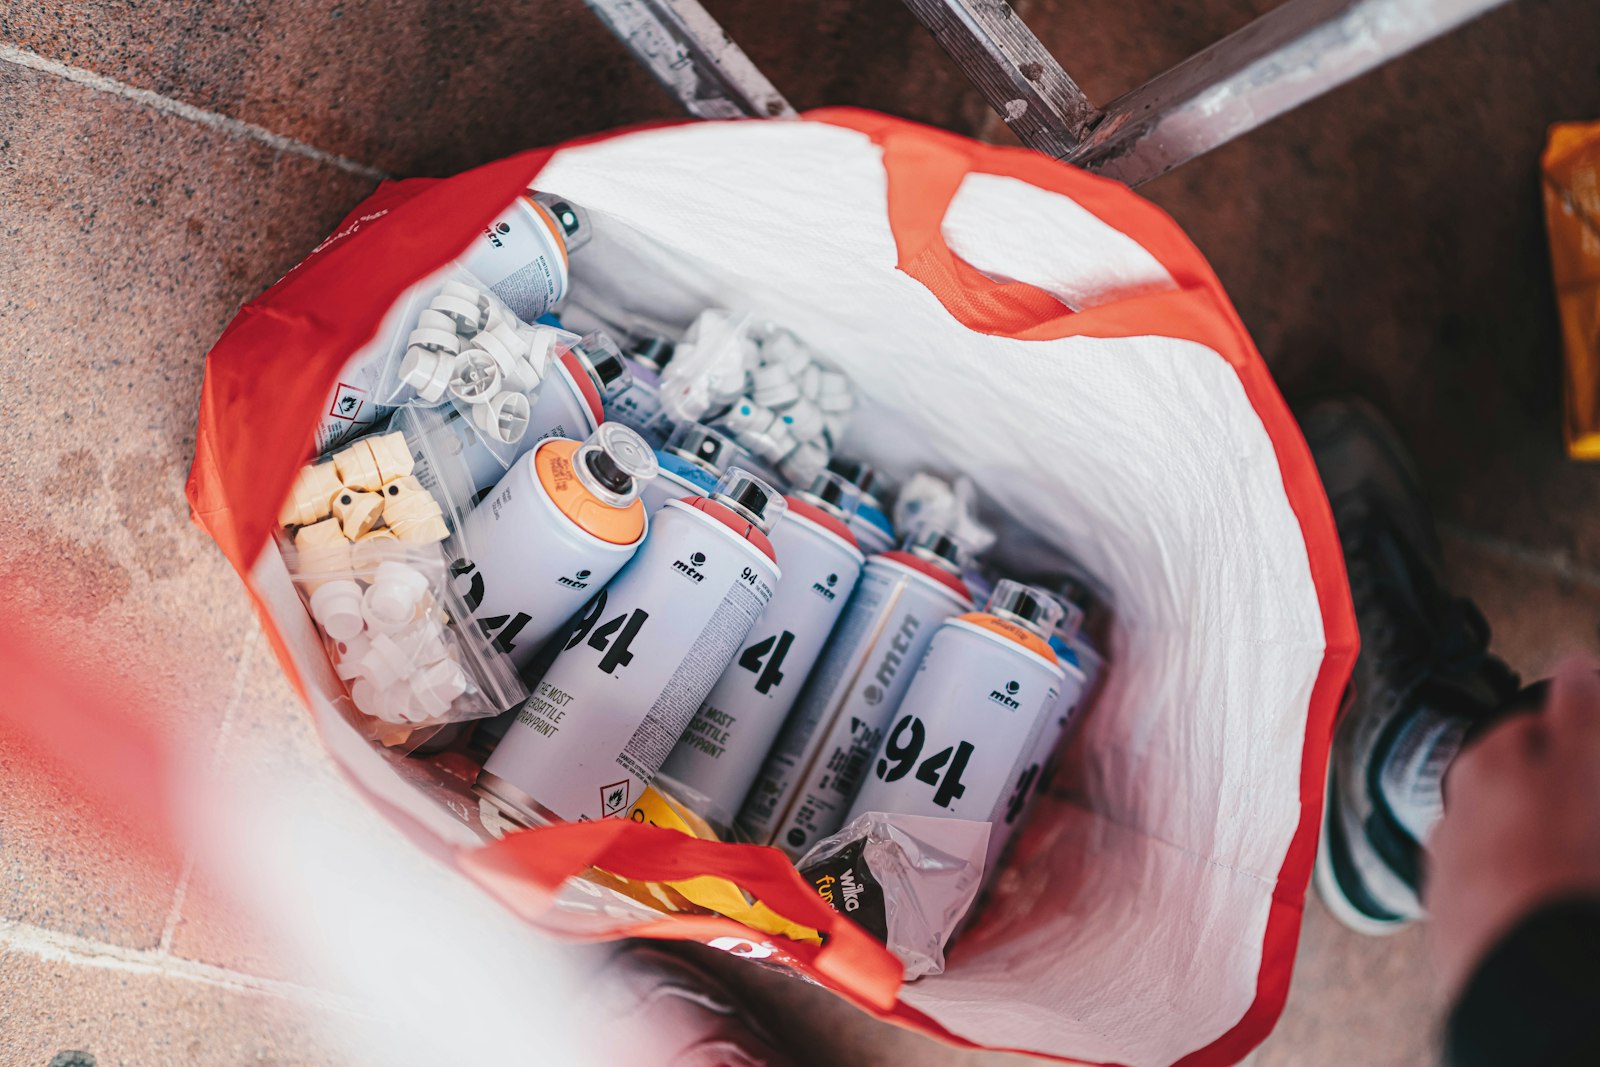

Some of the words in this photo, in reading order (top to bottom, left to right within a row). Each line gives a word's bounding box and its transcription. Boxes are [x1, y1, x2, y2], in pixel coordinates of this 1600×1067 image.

[672, 559, 705, 582] mtn
[740, 566, 758, 586] 94
[557, 576, 588, 589] mtn
[812, 582, 836, 600] mtn
[875, 613, 920, 689] mtn
[547, 686, 575, 708] MOST
[989, 690, 1020, 710] mtn
[705, 706, 737, 729] MOST
[876, 714, 975, 809] 94
[839, 868, 865, 912] wilko
